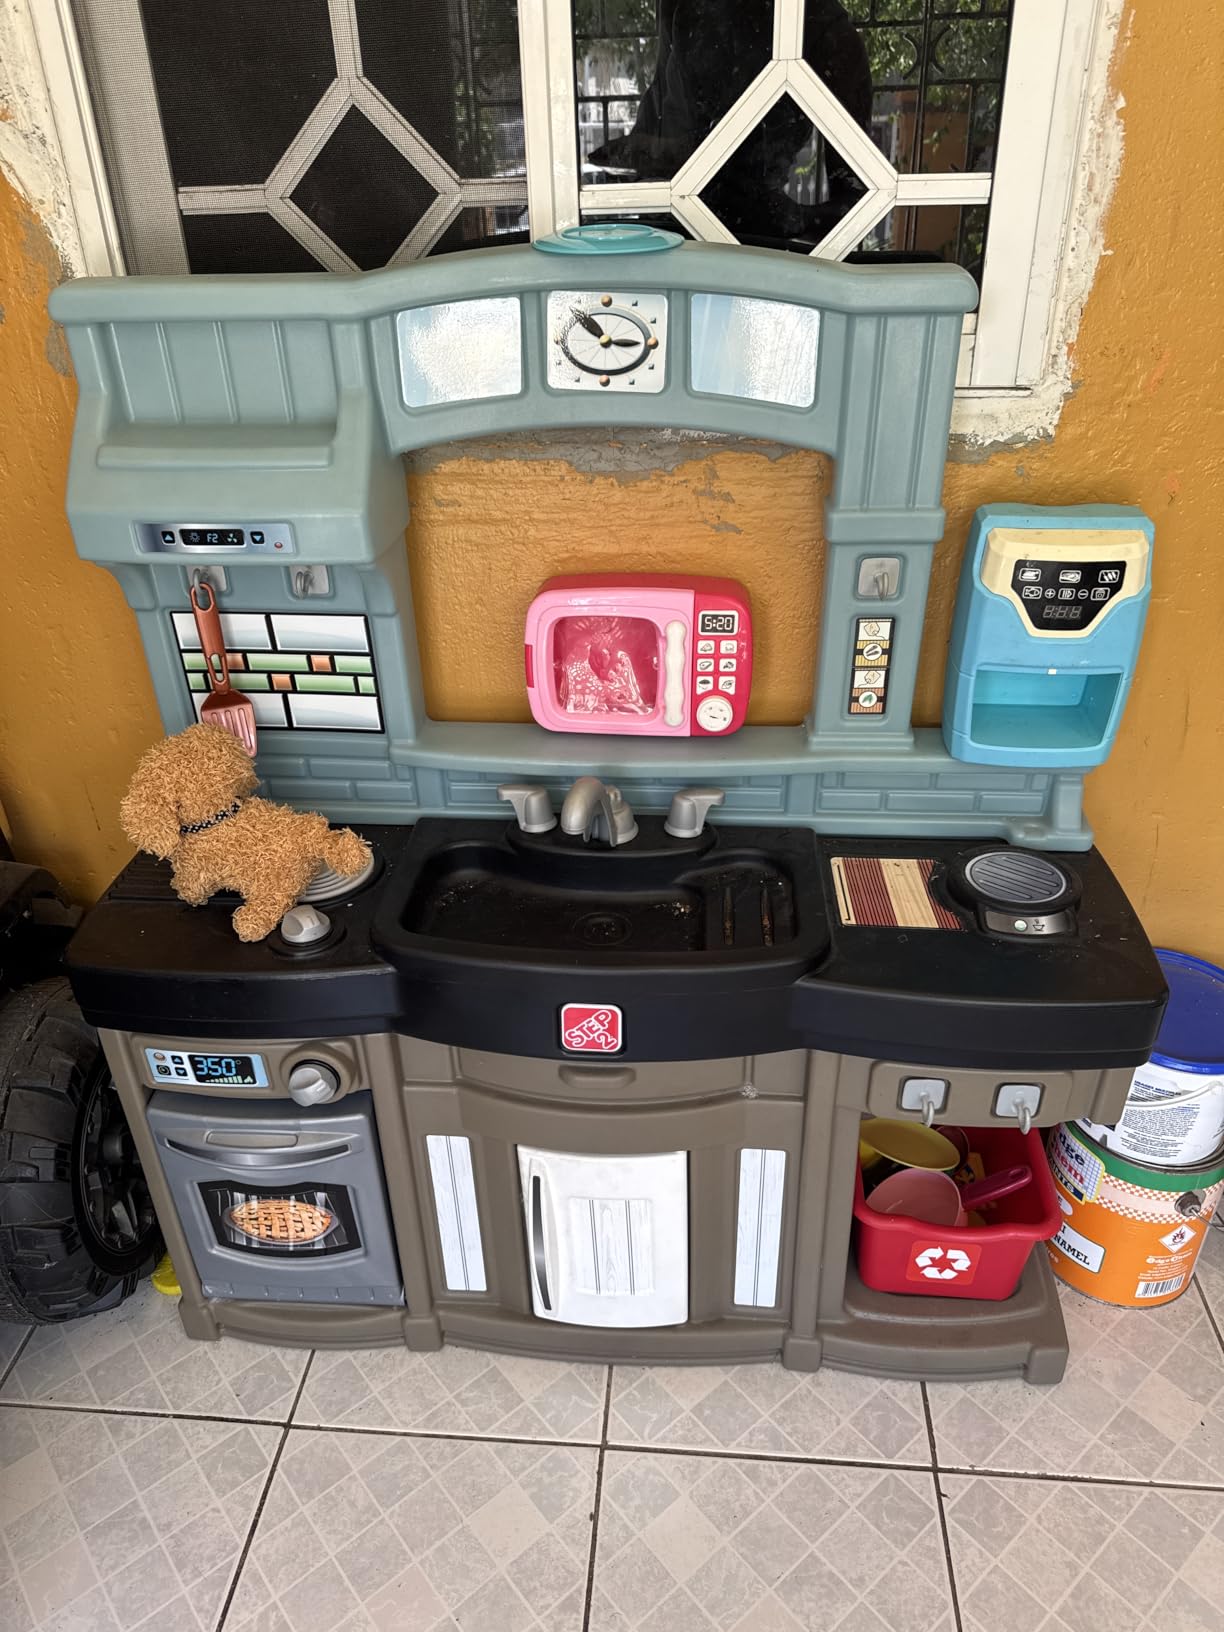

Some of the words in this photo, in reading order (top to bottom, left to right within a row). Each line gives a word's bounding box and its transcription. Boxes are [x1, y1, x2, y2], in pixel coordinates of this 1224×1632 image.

[206, 533, 219, 544] F2
[704, 616, 733, 631] 5:20
[565, 1009, 612, 1047] STEP
[1053, 1233, 1090, 1266] NAMEL
